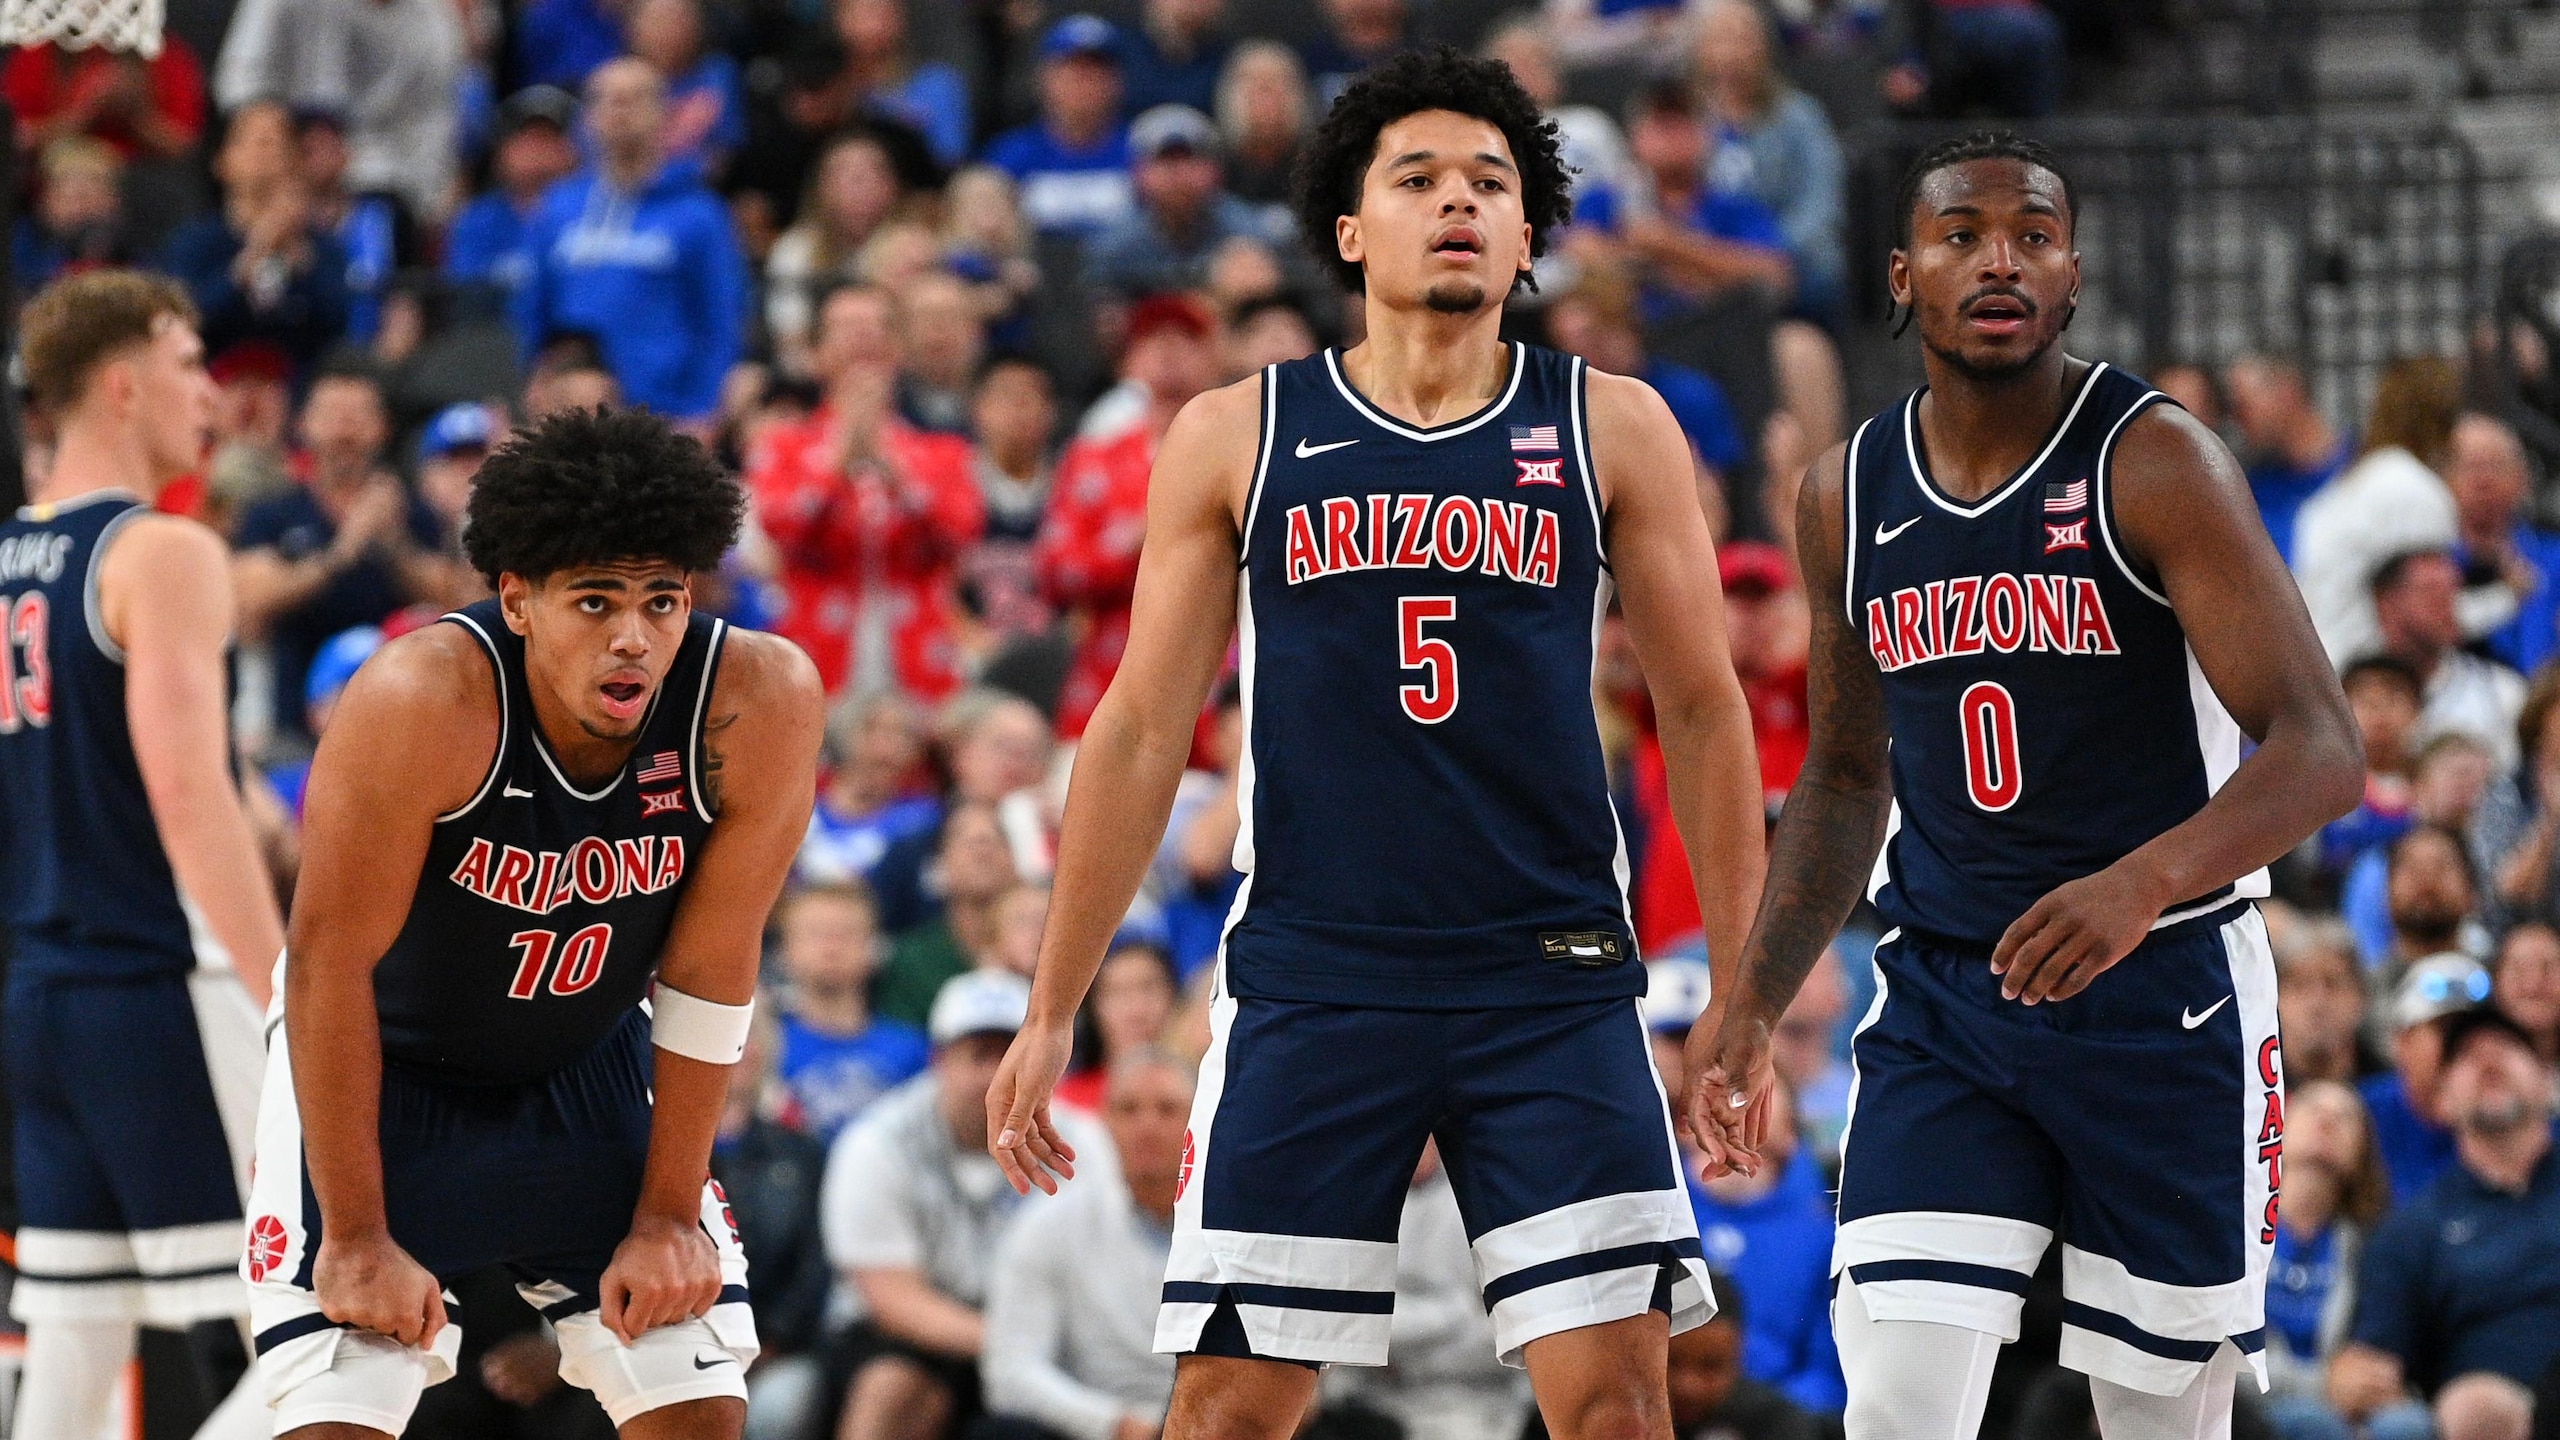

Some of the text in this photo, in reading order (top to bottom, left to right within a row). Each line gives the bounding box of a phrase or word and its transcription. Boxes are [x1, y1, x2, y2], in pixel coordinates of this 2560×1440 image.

[1286, 494, 1560, 588] ARIZONA
[0, 590, 52, 733] 13
[1398, 596, 1459, 724] 5
[1866, 572, 2121, 673] ARIZONA
[1959, 680, 2023, 813] 0
[449, 836, 685, 915] ARIZONA
[508, 922, 613, 1000] 10
[2257, 1034, 2284, 1245] CATS
